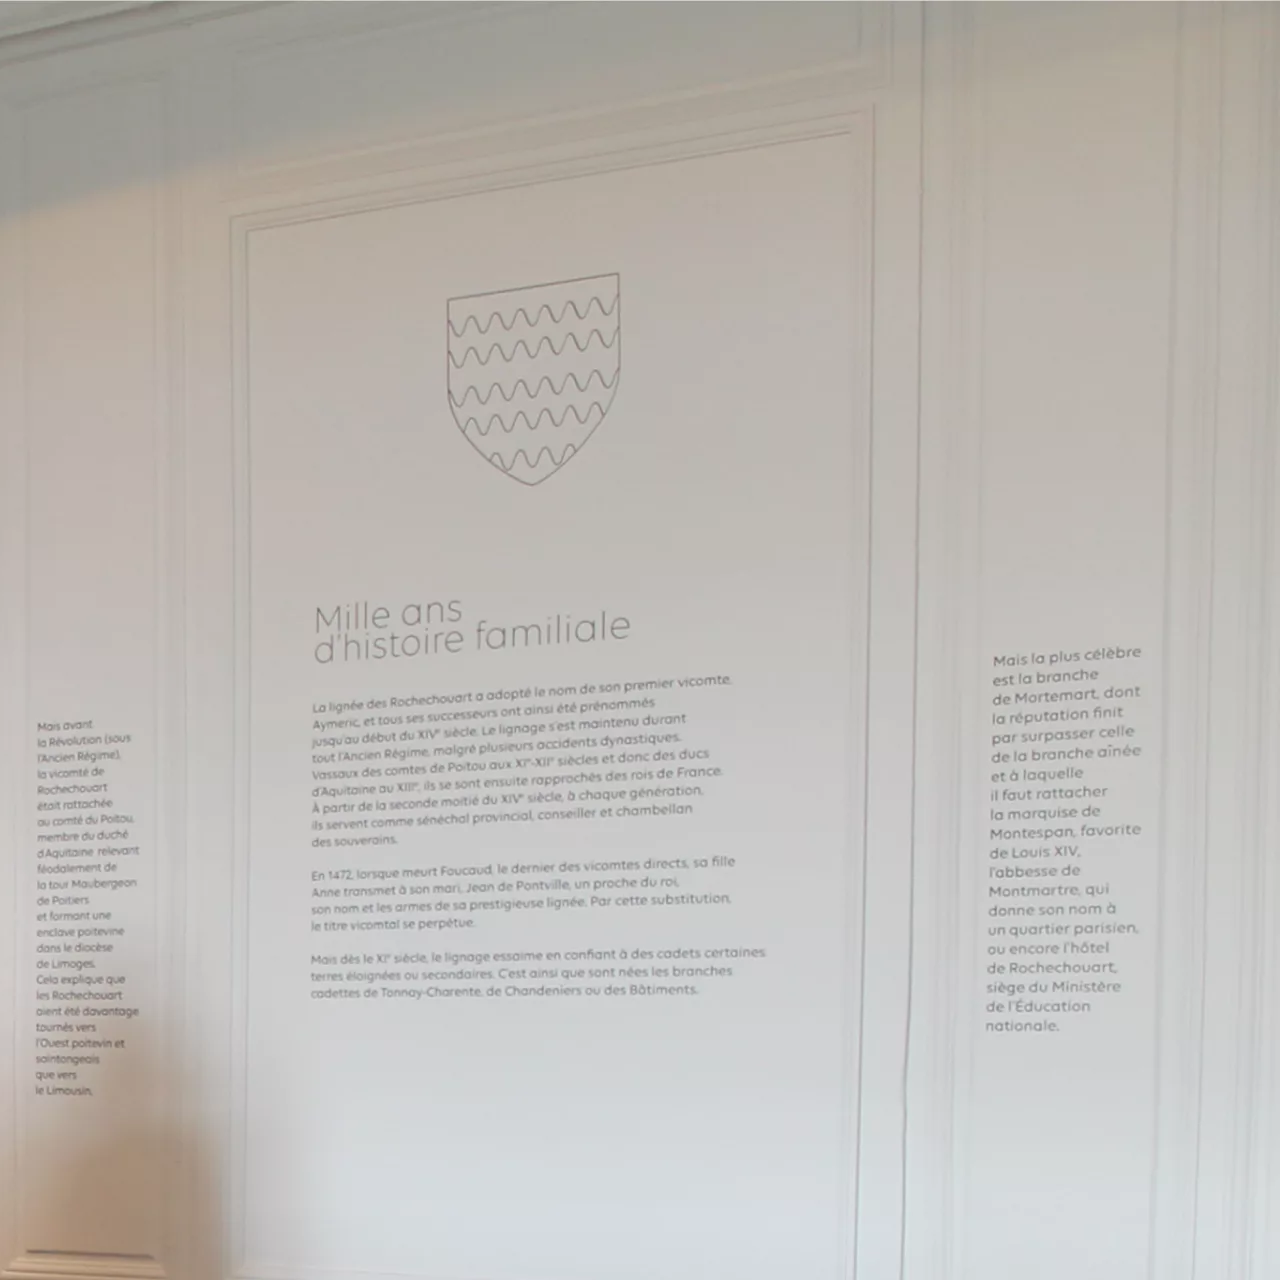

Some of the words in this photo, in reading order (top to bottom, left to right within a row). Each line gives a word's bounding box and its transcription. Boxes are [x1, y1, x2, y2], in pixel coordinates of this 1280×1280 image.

[316, 601, 391, 633] Mille
[401, 599, 463, 627] ans
[314, 627, 464, 664] d'histoire
[477, 609, 632, 650] familiale
[993, 653, 1027, 666] Mais
[1031, 652, 1046, 664] la
[1047, 650, 1080, 666] plus
[1083, 646, 1141, 661] célèbre
[992, 674, 1015, 686] est
[1018, 672, 1033, 685] la
[1035, 668, 1098, 684] branche
[312, 703, 327, 713] La
[328, 699, 364, 715] lignée
[365, 698, 387, 710] des
[389, 691, 473, 708] Rochechouart
[475, 694, 484, 702] a
[485, 688, 531, 703] adopté
[534, 687, 545, 698] le
[548, 688, 577, 697] nom
[579, 684, 596, 695] de
[598, 685, 621, 694] son
[623, 679, 674, 695] premier
[991, 693, 1011, 705] de
[1103, 686, 1140, 699] dont
[363, 716, 375, 726] et
[377, 715, 403, 725] tous
[405, 714, 424, 723] ses
[427, 710, 498, 722] successeurs
[500, 705, 522, 718] ont
[523, 704, 553, 716] ainsi
[556, 702, 578, 714] été
[579, 698, 655, 716] prénommés
[992, 712, 1007, 724] la
[1009, 708, 1090, 726] réputation
[1092, 705, 1124, 719] finit
[991, 733, 1016, 746] par
[1020, 730, 1094, 744] surpasser
[1098, 725, 1135, 738] celle
[990, 751, 1010, 762] de
[1013, 750, 1029, 761] la
[1030, 747, 1093, 761] branche
[1097, 745, 1141, 758] aînée
[990, 771, 1007, 782] et
[1008, 769, 1020, 781] à
[1022, 766, 1083, 784] laquelle
[990, 789, 998, 800] il
[1002, 788, 1032, 800] faut
[1036, 785, 1108, 799] rattacher
[311, 819, 323, 830] ils
[325, 818, 367, 829] servent
[370, 817, 413, 827] comme
[416, 812, 469, 825] sénéchal
[537, 807, 595, 820] conseiller
[599, 807, 613, 818] et
[614, 804, 693, 817] chambellan
[990, 808, 1005, 820] la
[1007, 806, 1078, 822] marquise
[1080, 805, 1101, 817] de
[1080, 823, 1141, 836] favorite
[311, 836, 331, 847] des
[988, 847, 1008, 859] de
[1011, 846, 1050, 858] Louis
[311, 870, 325, 880] En
[356, 869, 399, 881] lorsque
[401, 867, 437, 877] meurt
[497, 863, 508, 874] le
[510, 862, 555, 874] dernier
[558, 861, 580, 872] des
[583, 860, 641, 871] vicomtes
[692, 859, 709, 868] sa
[711, 856, 735, 867] fille
[1060, 864, 1080, 876] de
[1085, 882, 1109, 898] qui
[311, 906, 331, 914] son
[333, 905, 359, 913] nom
[361, 903, 373, 913] et
[375, 902, 392, 912] les
[394, 903, 432, 912] armes
[434, 900, 450, 911] de
[452, 902, 466, 911] sa
[469, 899, 544, 913] prestigieuse
[590, 896, 611, 907] Par
[614, 895, 648, 907] cette
[987, 904, 1035, 916] donne
[1038, 906, 1065, 915] son
[1068, 905, 1103, 915] nom
[1106, 902, 1117, 914] à
[311, 920, 321, 931] le
[324, 921, 347, 931] titre
[350, 919, 400, 930] vicomtal
[402, 921, 415, 929] se
[987, 926, 1007, 935] un
[1007, 922, 1070, 938] quartier
[986, 945, 1005, 954] ou
[1008, 945, 1059, 954] encore
[986, 962, 1005, 974] de
[986, 981, 1025, 996] siège
[1027, 980, 1048, 992] du
[1052, 980, 1121, 992] Ministère
[985, 1000, 1004, 1012] de
